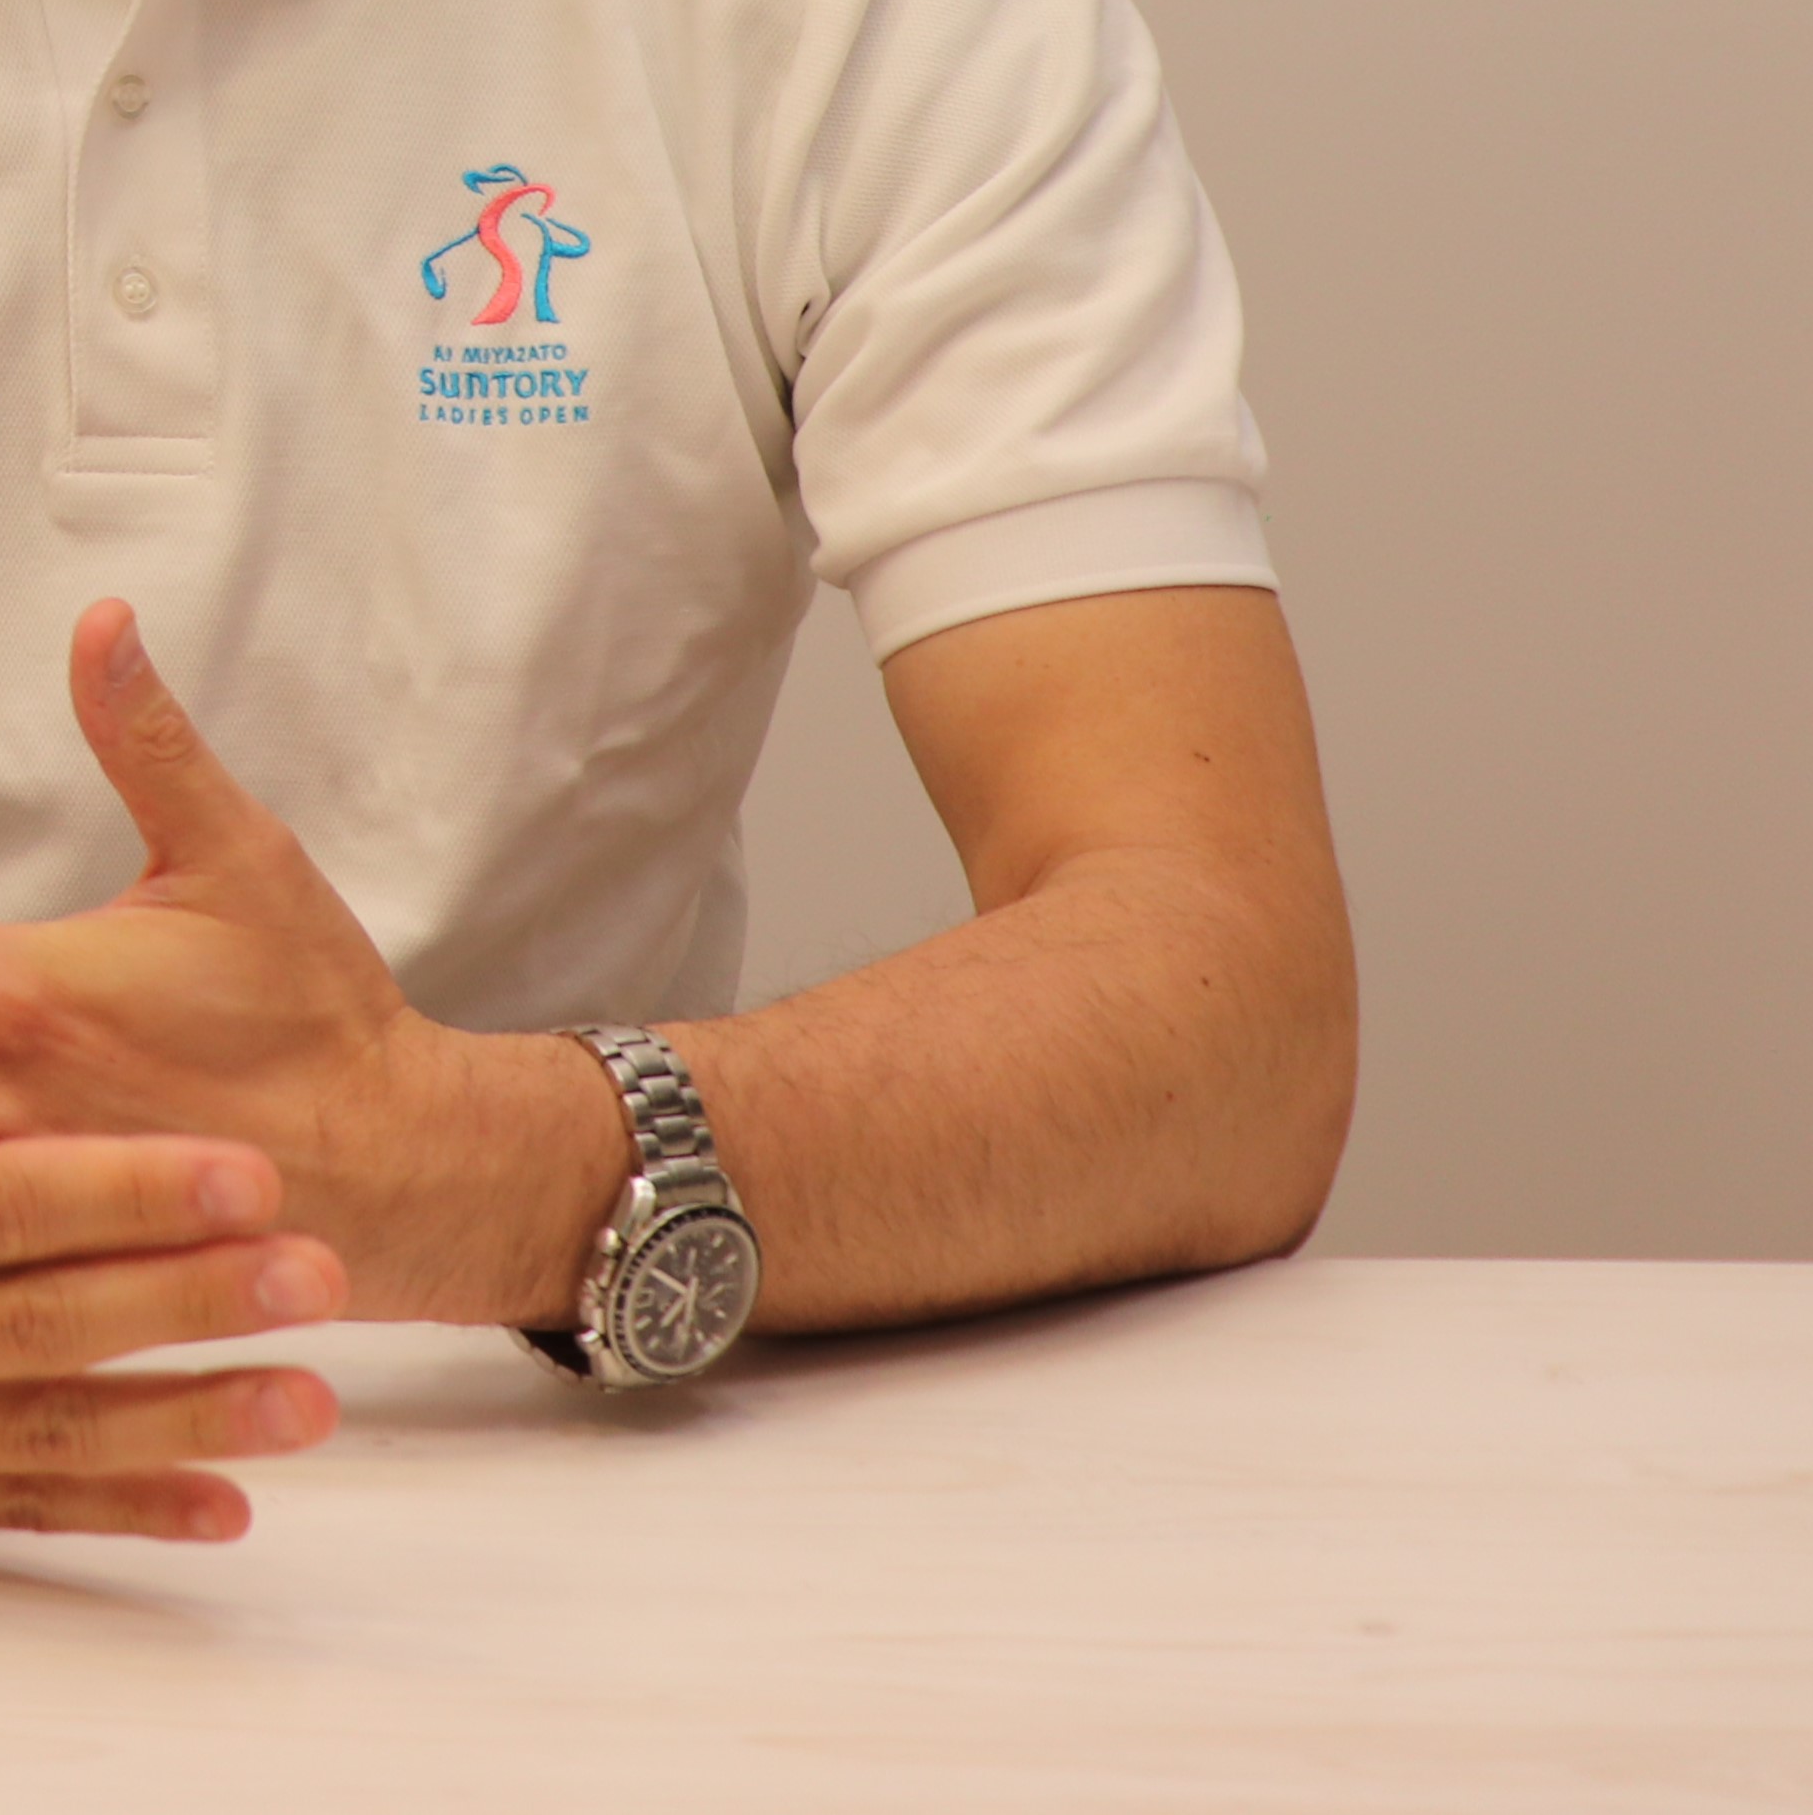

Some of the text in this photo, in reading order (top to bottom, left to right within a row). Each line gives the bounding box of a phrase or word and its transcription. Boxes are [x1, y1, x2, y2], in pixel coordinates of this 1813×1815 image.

[463, 343, 568, 365] MIYAZATO
[419, 404, 590, 426] LADIES OPEN
